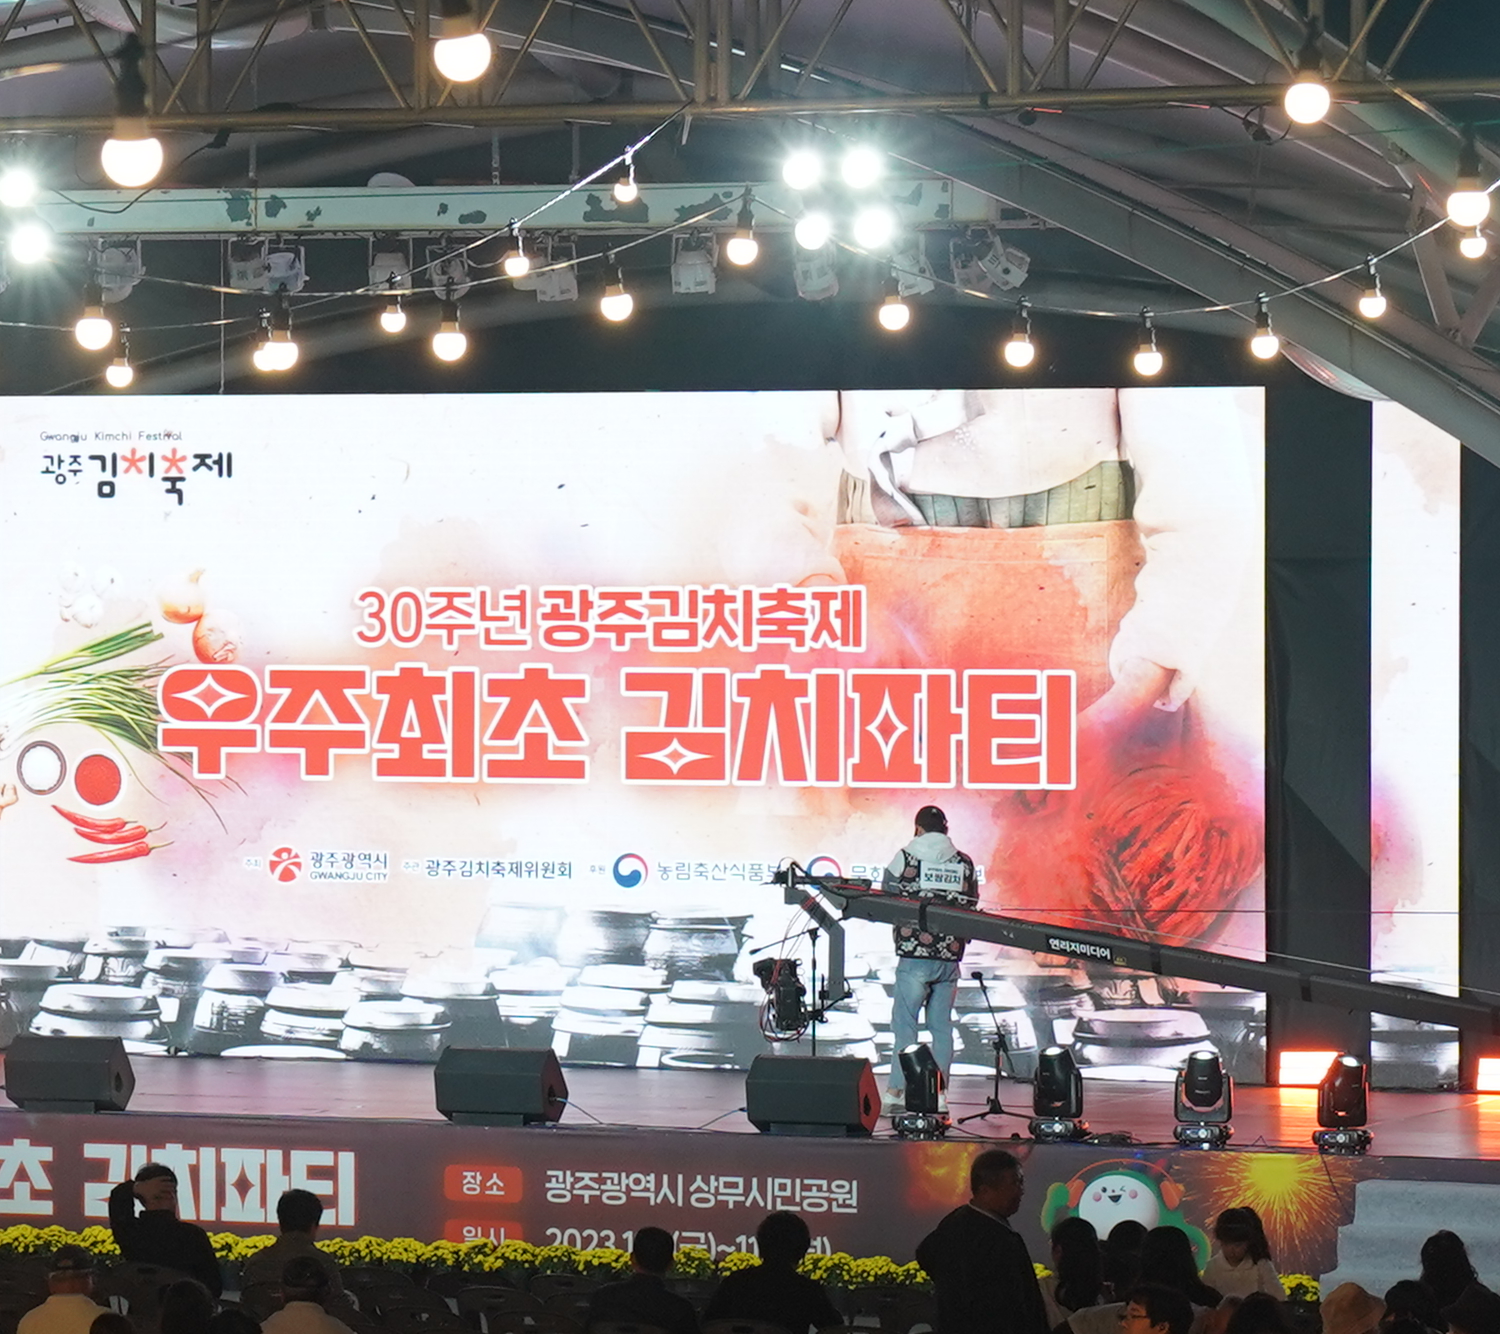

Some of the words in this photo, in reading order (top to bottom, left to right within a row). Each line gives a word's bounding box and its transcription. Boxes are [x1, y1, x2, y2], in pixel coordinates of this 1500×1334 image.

[40, 431, 87, 443] Gwangju
[95, 431, 132, 441] Kimchi
[138, 430, 182, 441] Festival
[357, 588, 529, 648] 30주년
[539, 586, 867, 651] 광주김치축제
[158, 665, 589, 783] 우주최초
[621, 665, 1078, 789] 김치파티
[310, 851, 387, 869] 광주광역시
[425, 859, 572, 879] 광주김치축제위원회
[310, 871, 363, 881] GWANGJU
[366, 871, 388, 881] CITY
[462, 1171, 505, 1195] 장소
[545, 1169, 683, 1207] 광주광역시
[689, 1173, 859, 1214] 상무시민공원
